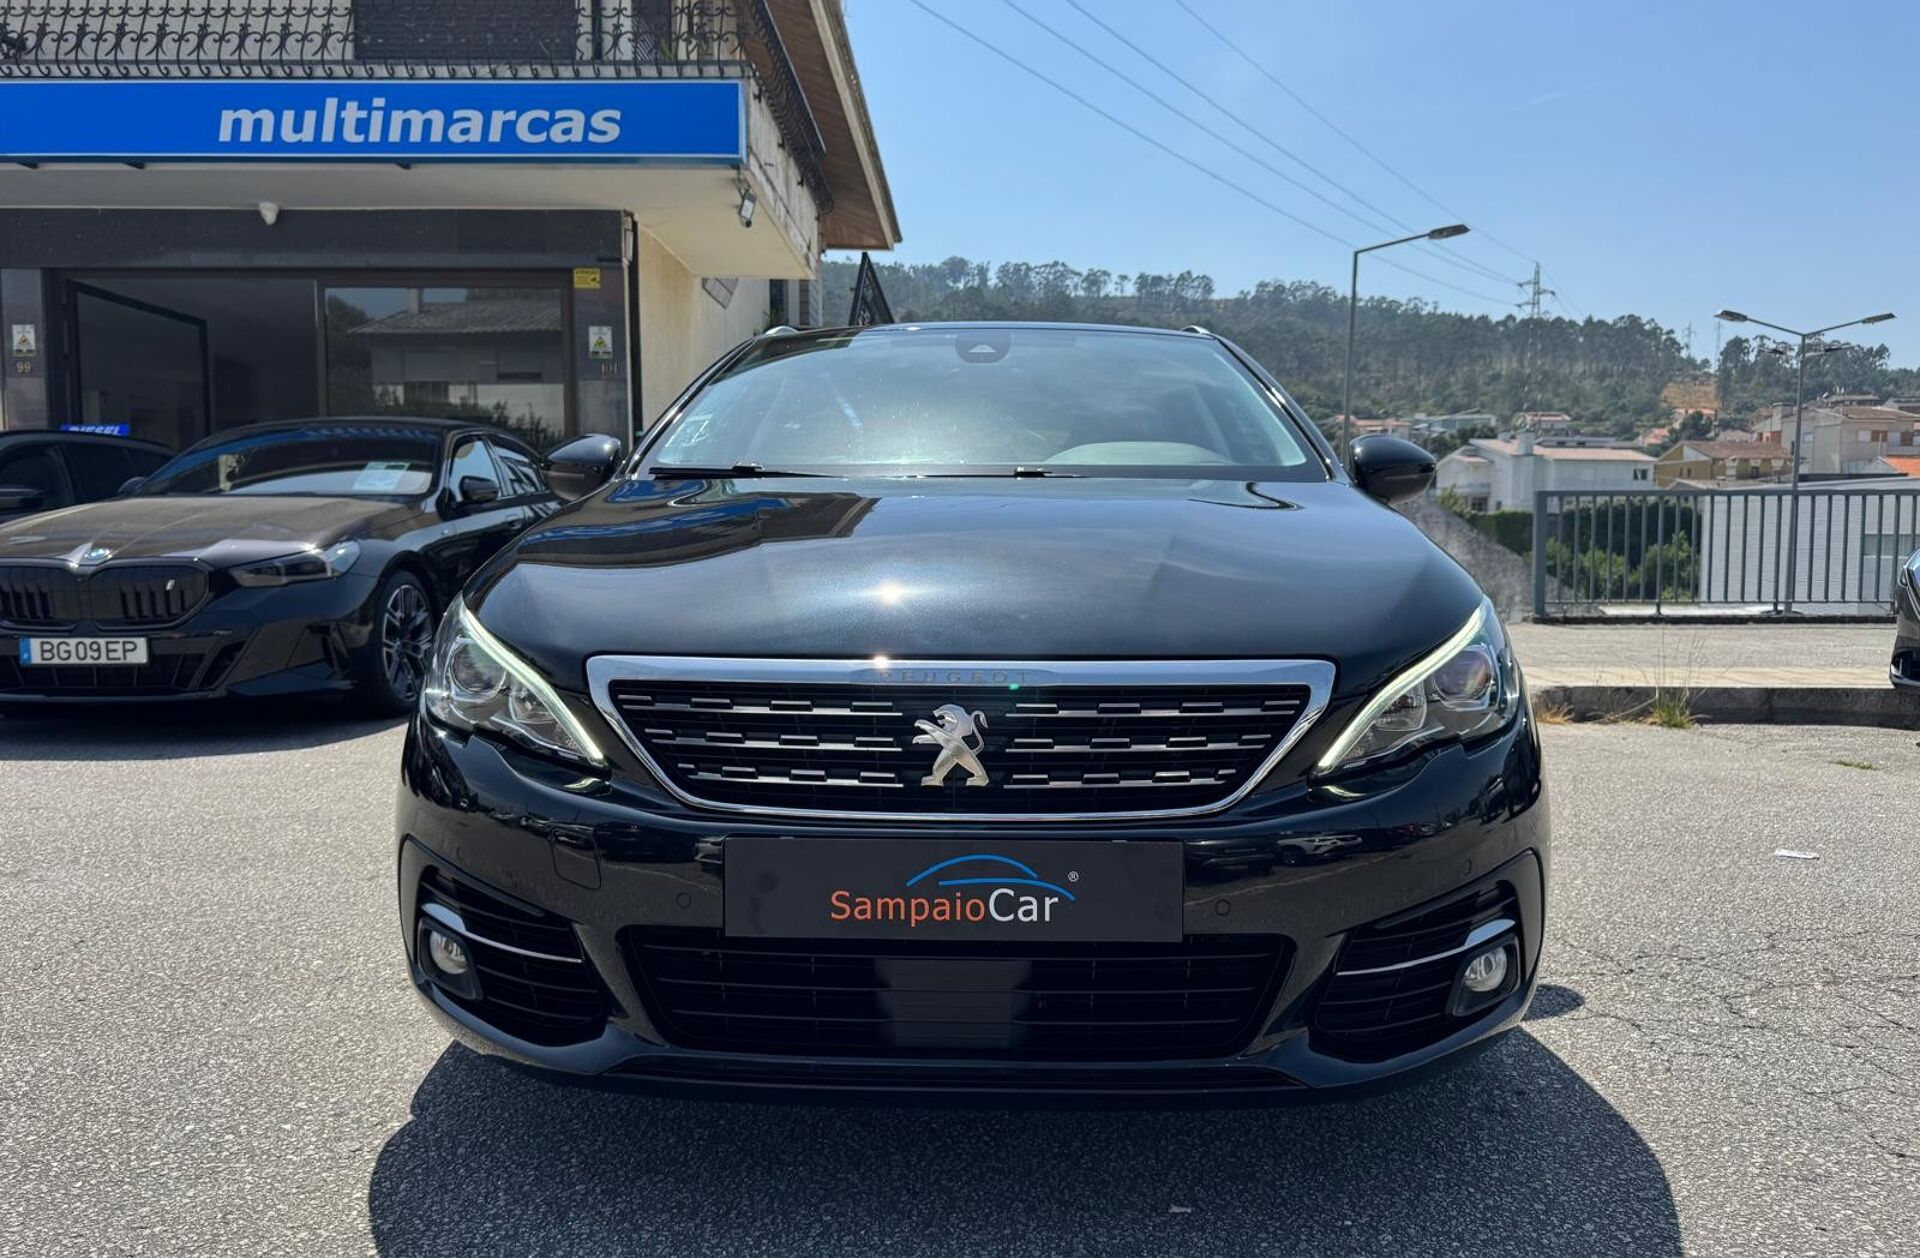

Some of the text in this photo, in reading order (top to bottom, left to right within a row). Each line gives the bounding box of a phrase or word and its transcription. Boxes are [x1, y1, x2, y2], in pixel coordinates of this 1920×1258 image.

[218, 97, 622, 144] multimarcas
[879, 671, 1030, 684] PEUGEOT
[830, 888, 1059, 927] SampaioCar
